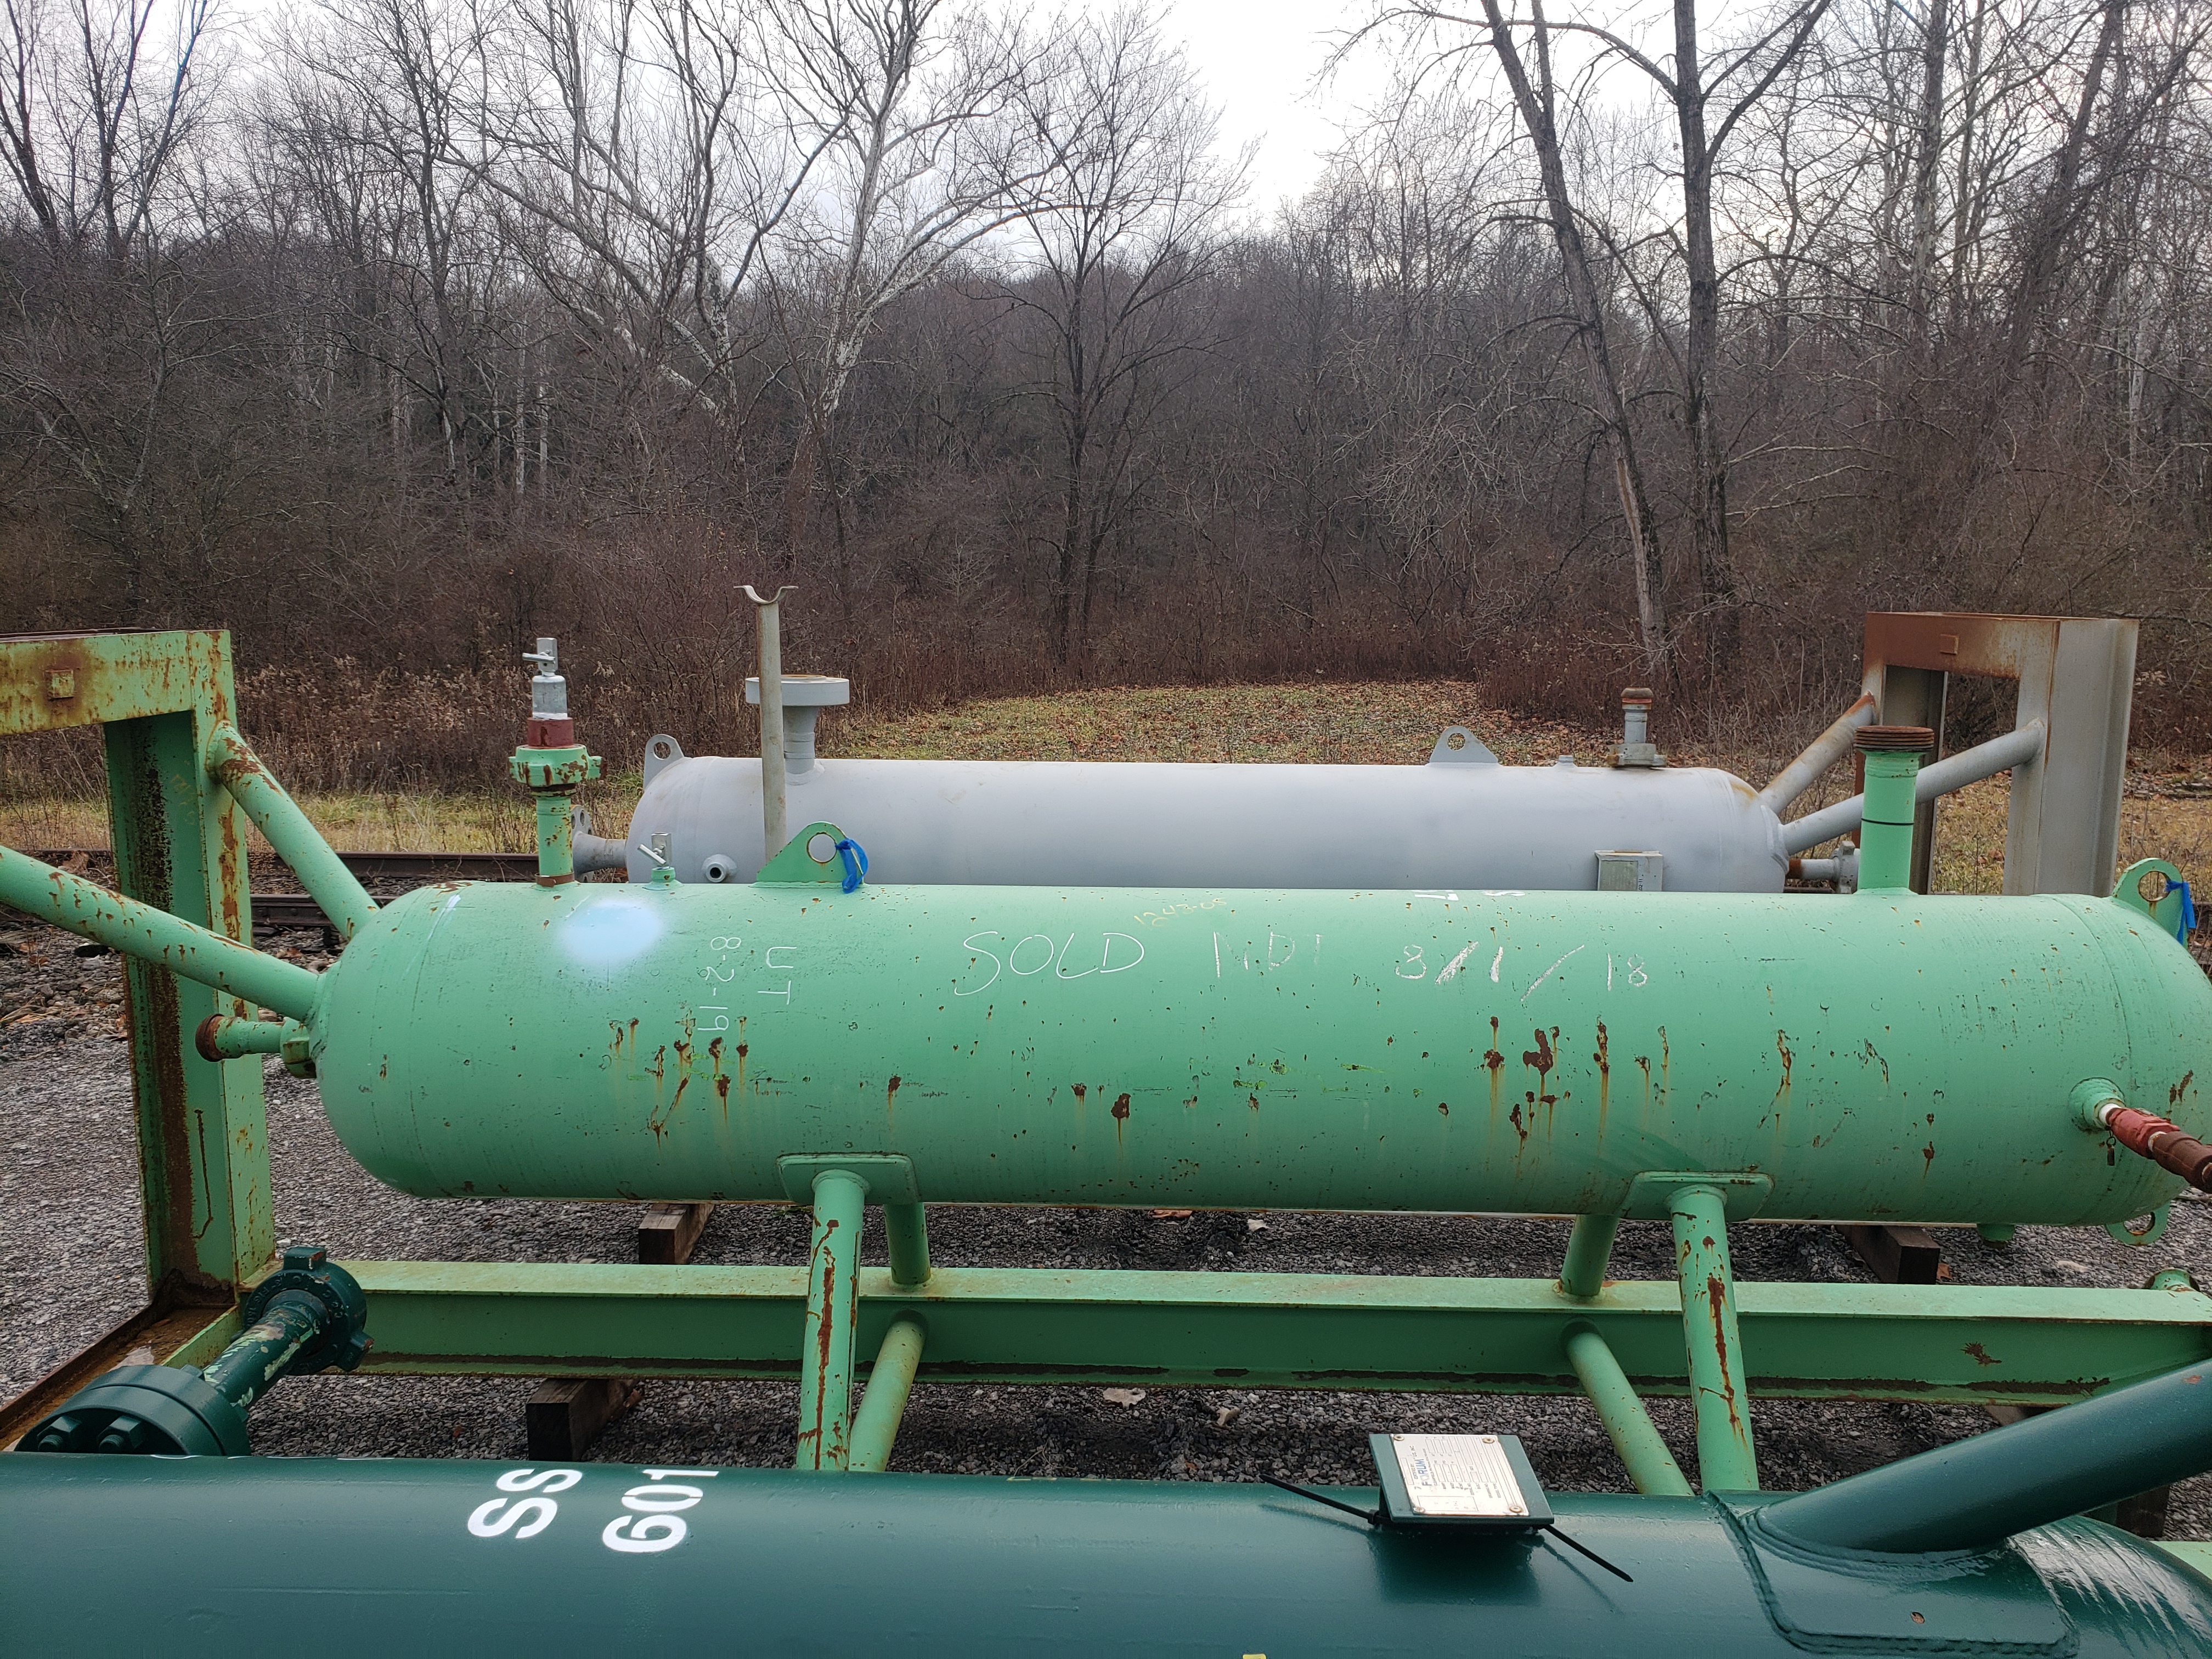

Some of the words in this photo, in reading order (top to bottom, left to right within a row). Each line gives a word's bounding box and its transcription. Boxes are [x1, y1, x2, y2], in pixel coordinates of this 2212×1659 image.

[697, 936, 741, 1032] 8-2-19
[757, 946, 797, 1006] UT
[954, 931, 1145, 995] SOLD
[467, 1469, 583, 1538] SS
[1414, 1458, 1432, 1486] FORUM
[602, 1469, 719, 1553] 601
